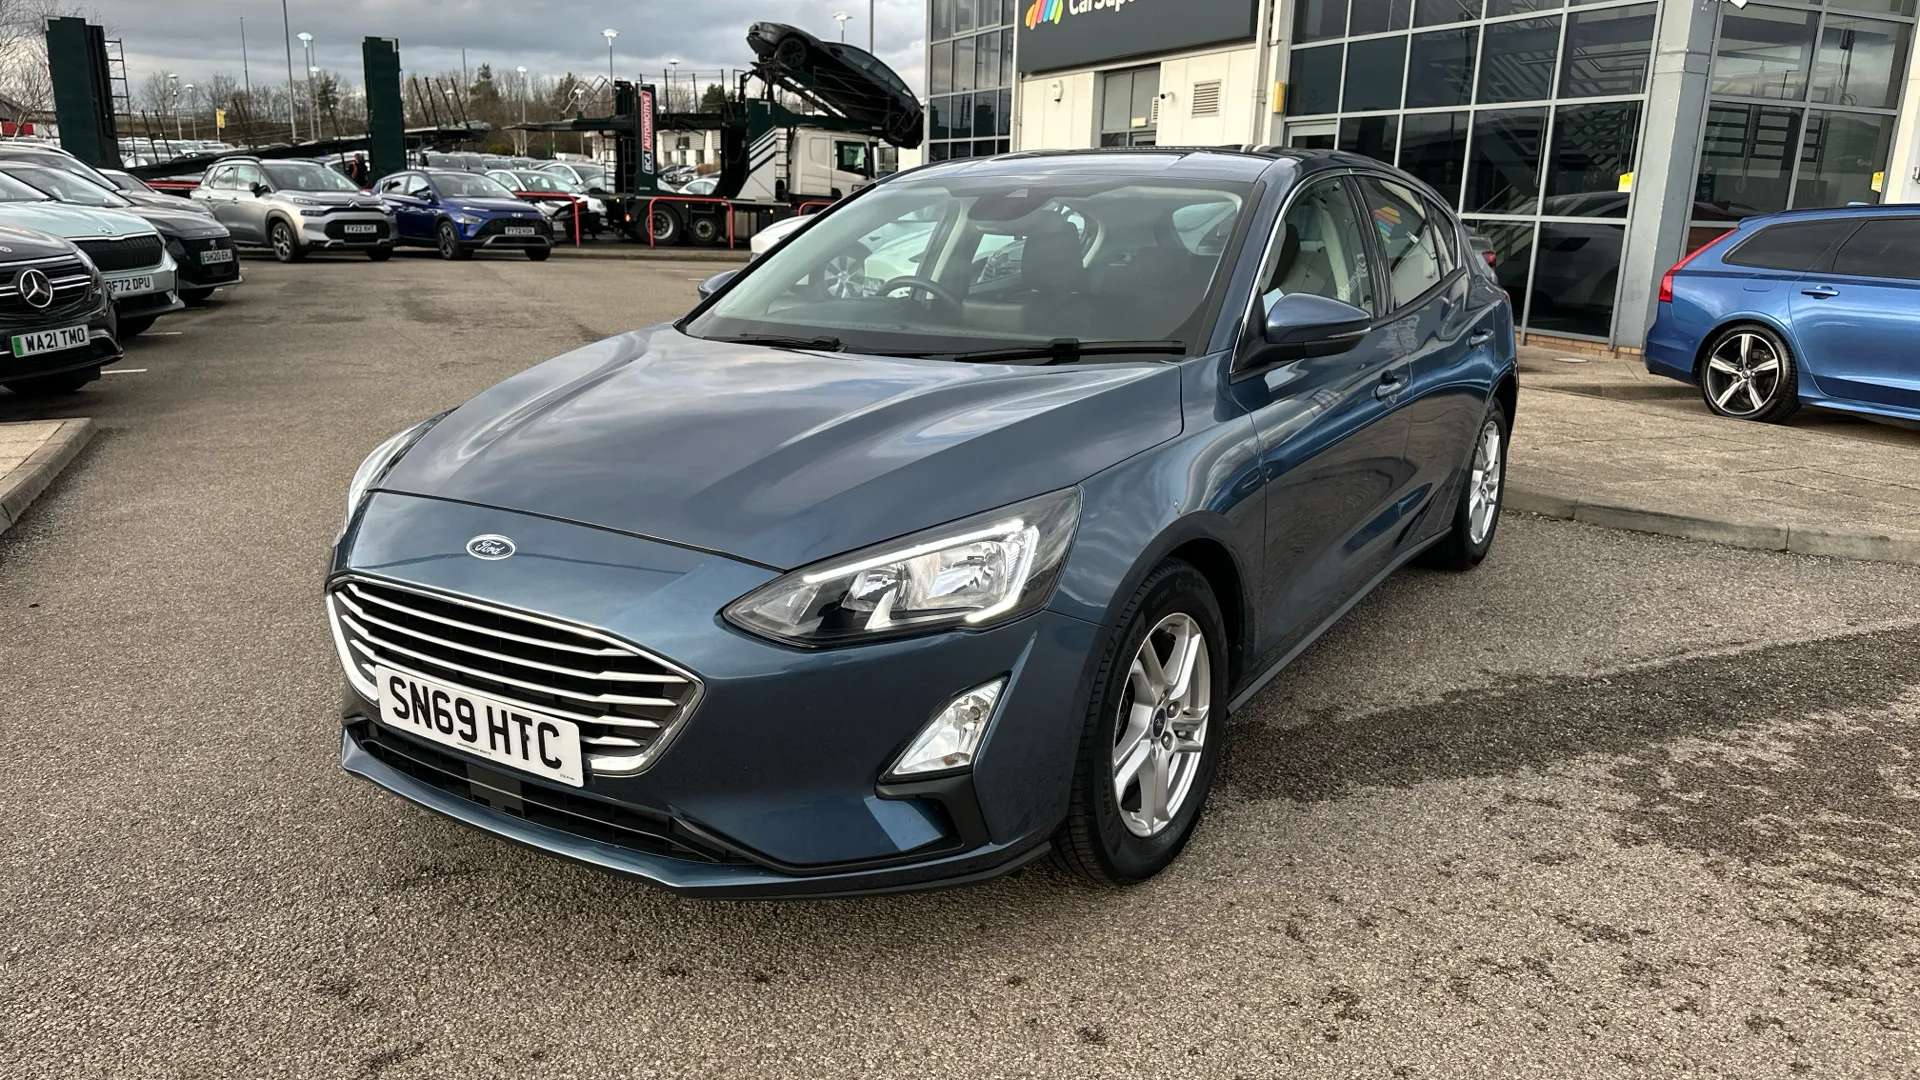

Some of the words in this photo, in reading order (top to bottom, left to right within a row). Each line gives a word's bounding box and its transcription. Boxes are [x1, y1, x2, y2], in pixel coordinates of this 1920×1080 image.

[643, 95, 651, 149] AUTOMOTIVE
[132, 277, 150, 290] DPU
[25, 331, 58, 352] WA21
[60, 327, 86, 346] TMO
[475, 539, 506, 555] Ford
[389, 675, 478, 743] SN69
[486, 705, 562, 769] HTC
